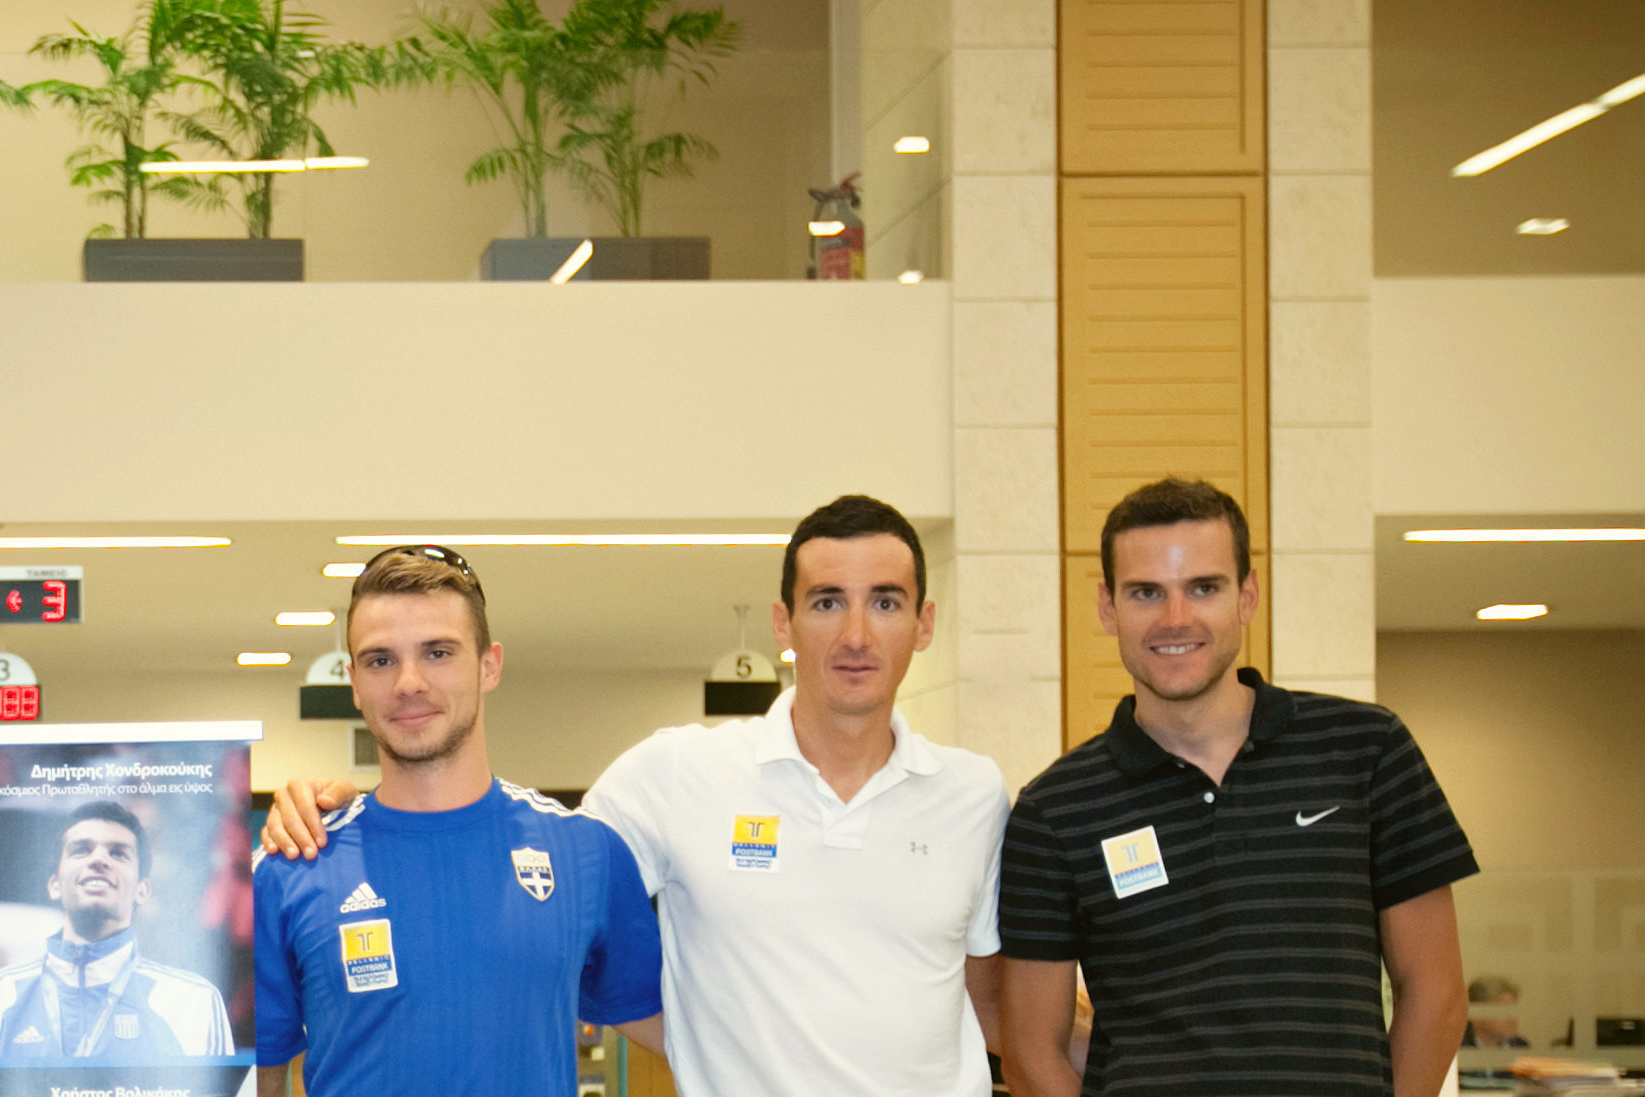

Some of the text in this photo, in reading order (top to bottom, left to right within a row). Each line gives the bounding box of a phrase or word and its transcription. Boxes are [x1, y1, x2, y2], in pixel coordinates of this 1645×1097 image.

[42, 580, 67, 622] 3
[330, 659, 344, 679] 4
[737, 656, 752, 679] 5
[31, 762, 212, 781] Δημήτρης Χονδροκούκης
[42, 782, 116, 797] Πρωταθλητής
[117, 784, 138, 794] στο
[139, 782, 166, 795] άλμα
[169, 783, 183, 794] εις
[184, 781, 213, 794] ύψος
[339, 898, 387, 913] adidas
[351, 962, 388, 974] POSTBANK
